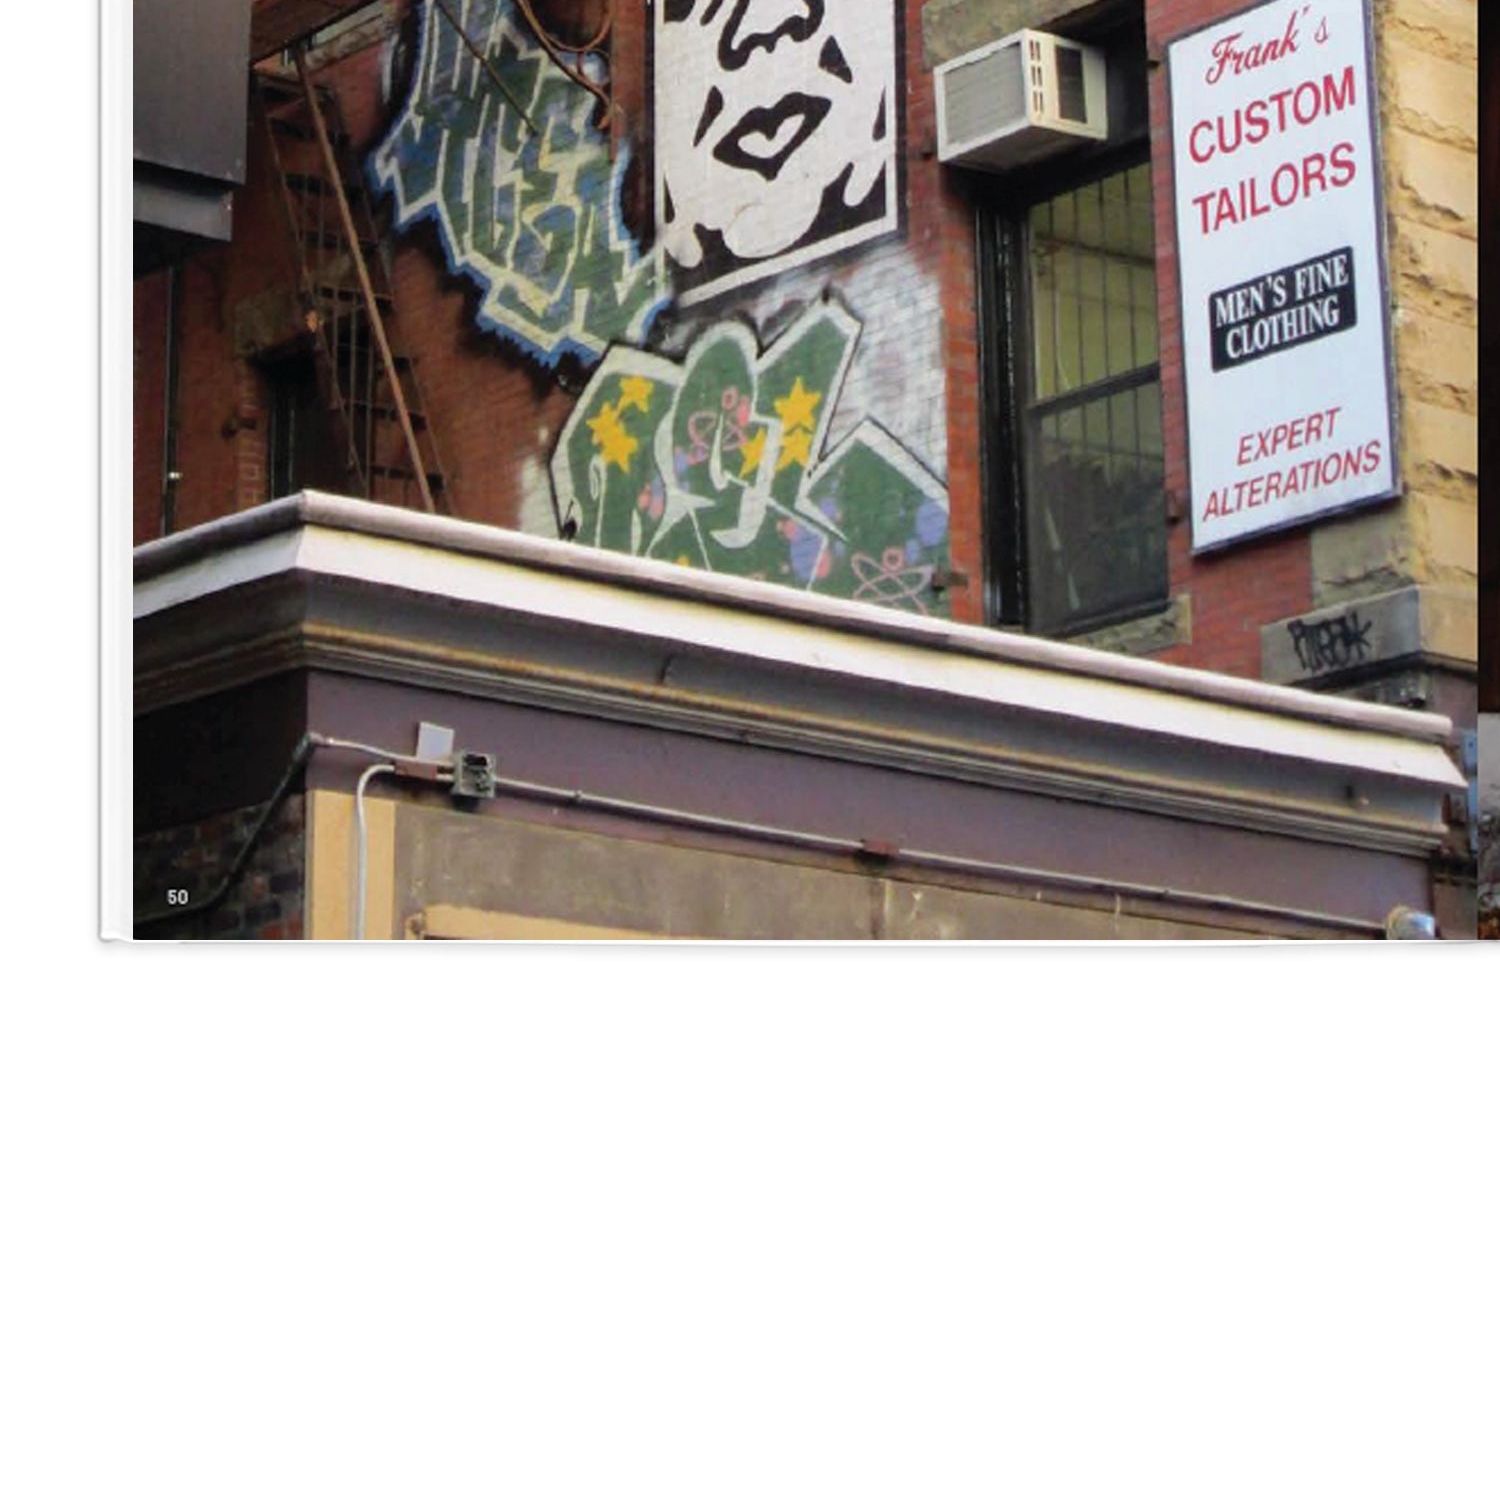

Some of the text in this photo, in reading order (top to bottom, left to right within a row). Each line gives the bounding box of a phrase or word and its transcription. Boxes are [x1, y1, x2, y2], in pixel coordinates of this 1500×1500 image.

[1205, 4, 1329, 85] Frank's
[1188, 65, 1356, 164] CUSTOM
[1192, 141, 1357, 235] TAILORS
[1214, 253, 1350, 328] MEN'S FINE
[1225, 294, 1340, 360] CLOTHING
[1237, 407, 1342, 467] EXPERT
[1202, 439, 1382, 523] ALTERATIONS
[167, 889, 189, 905] 50
